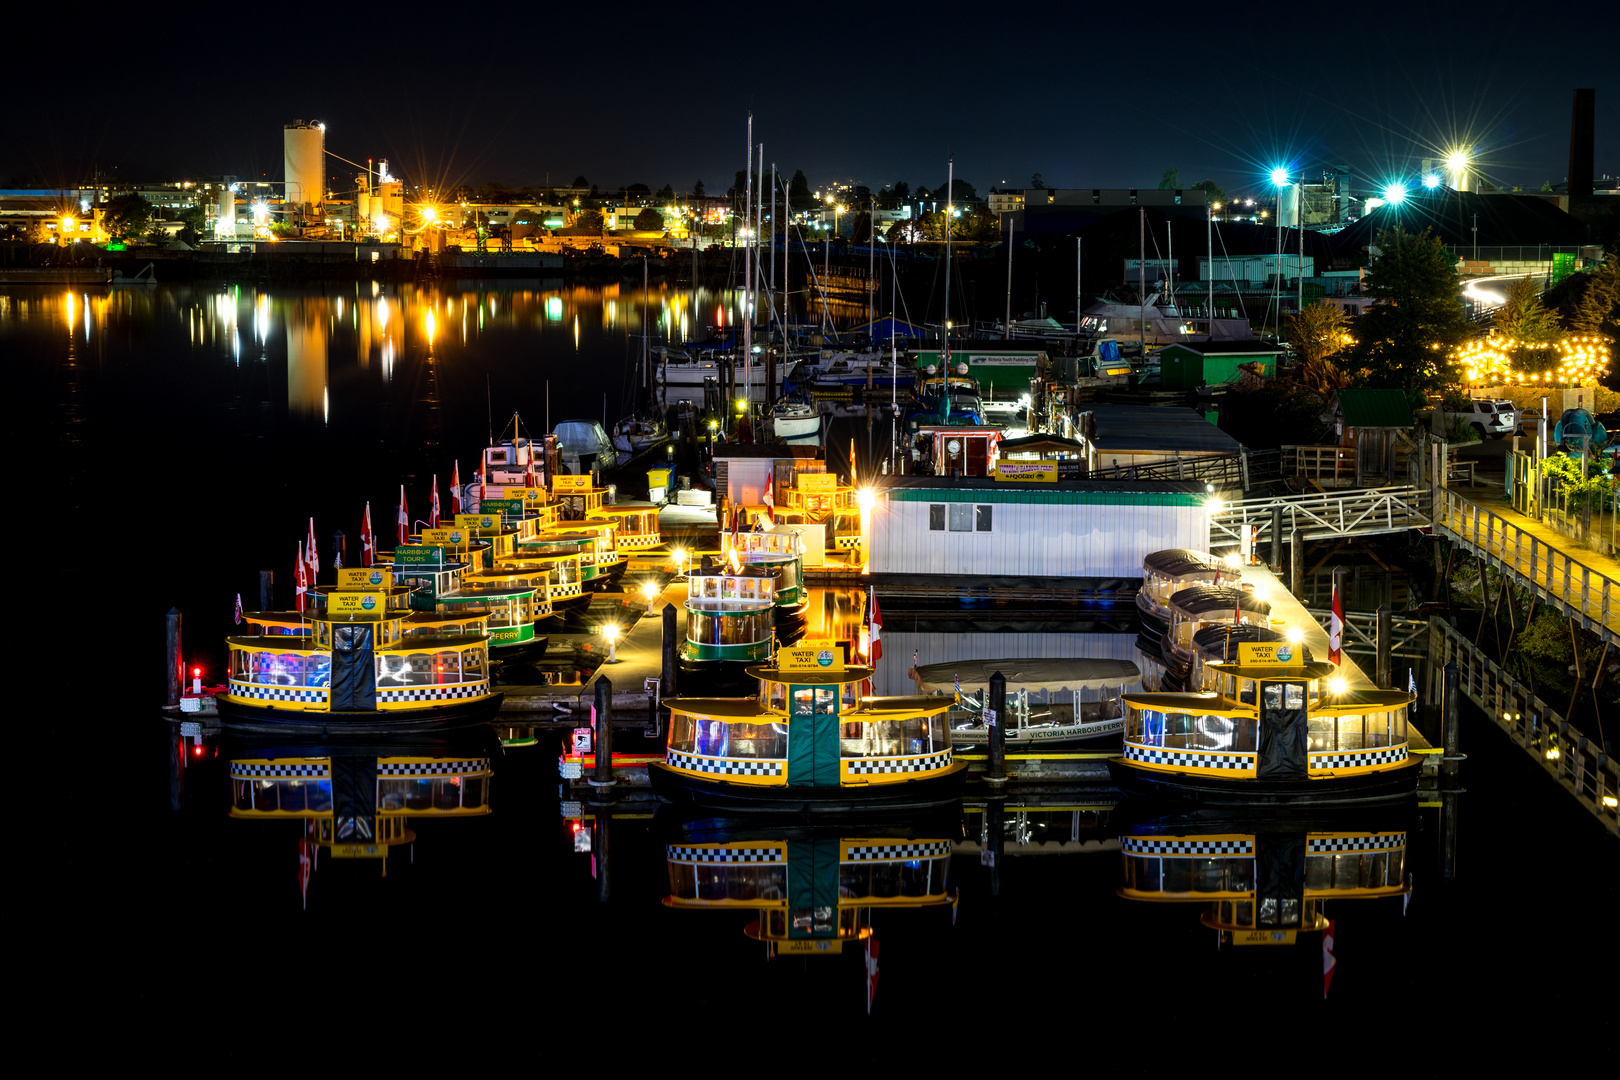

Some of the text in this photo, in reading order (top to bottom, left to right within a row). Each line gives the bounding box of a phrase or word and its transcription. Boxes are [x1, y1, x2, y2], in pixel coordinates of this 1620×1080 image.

[495, 631, 519, 640] FERRY
[1030, 722, 1124, 738] VICTORIA HARBOUR FERRY
